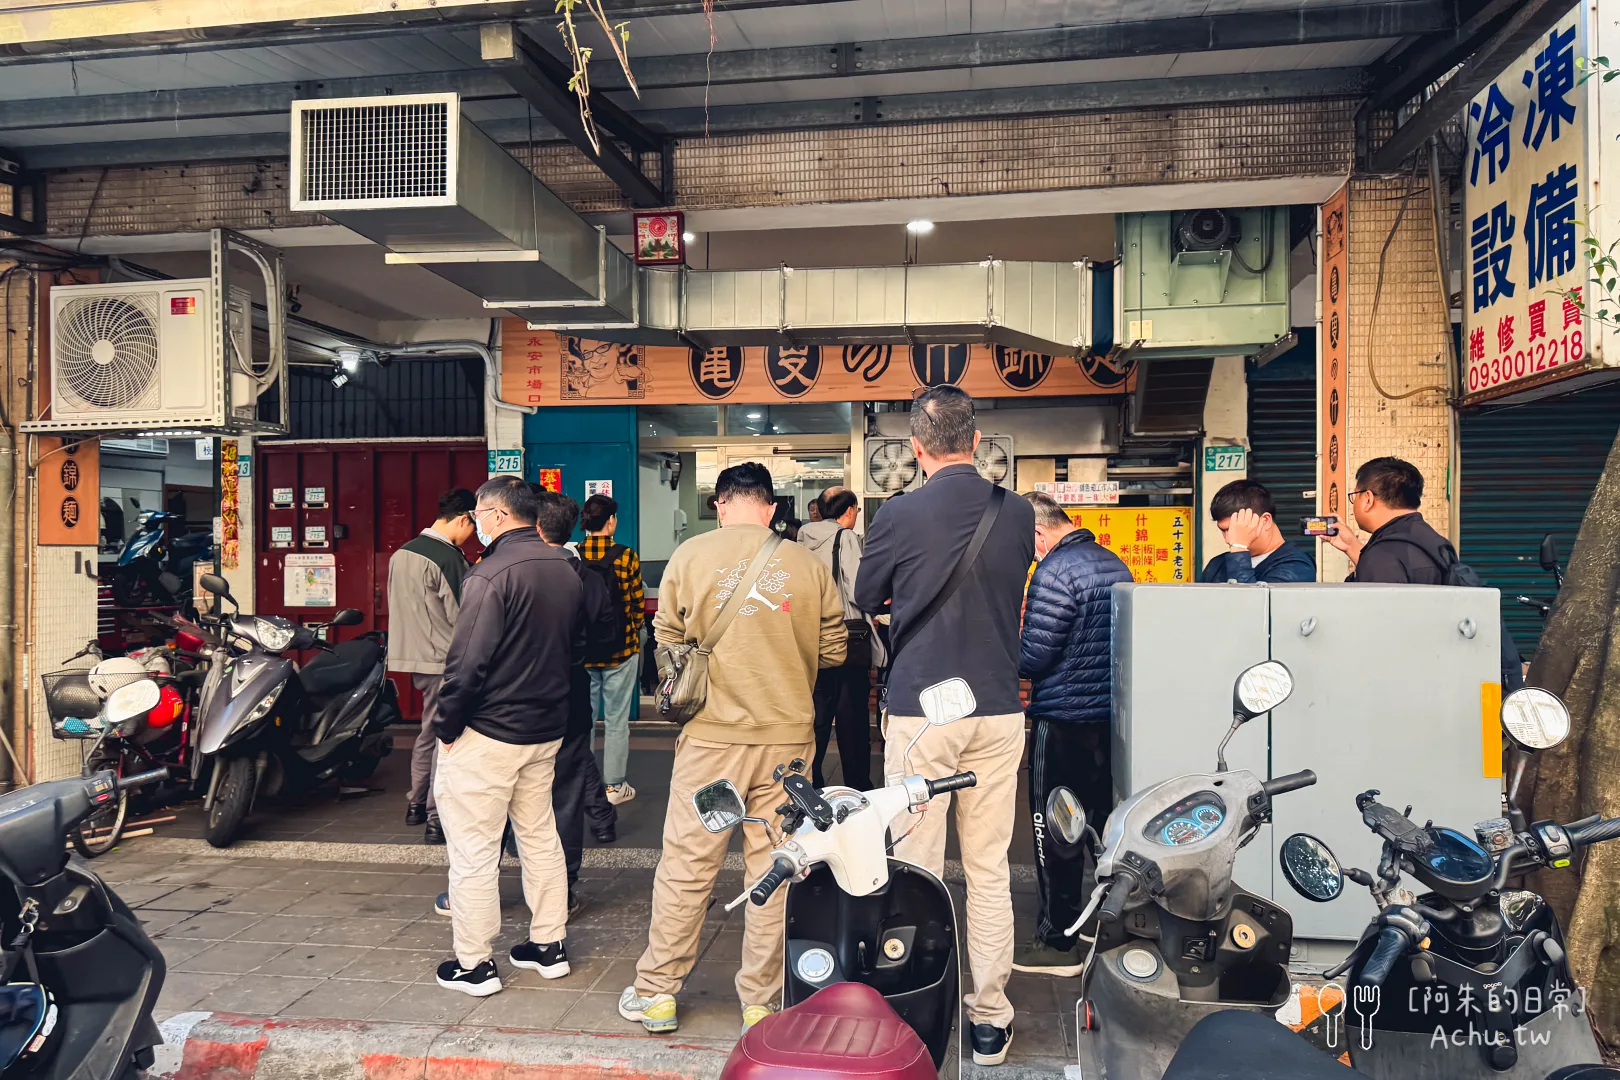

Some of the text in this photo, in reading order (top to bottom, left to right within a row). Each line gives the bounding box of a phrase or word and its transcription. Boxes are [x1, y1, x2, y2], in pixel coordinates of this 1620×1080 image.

[1470, 23, 1578, 188] 冷凍
[1470, 162, 1580, 314] 設備
[1469, 286, 1583, 363] 維修買賣
[526, 336, 543, 403] 永安市場口
[1469, 330, 1583, 391] 0930012218
[238, 463, 249, 475] 13
[498, 457, 519, 470] 215
[1218, 454, 1243, 468] 217
[1172, 516, 1184, 580] 五十年老店
